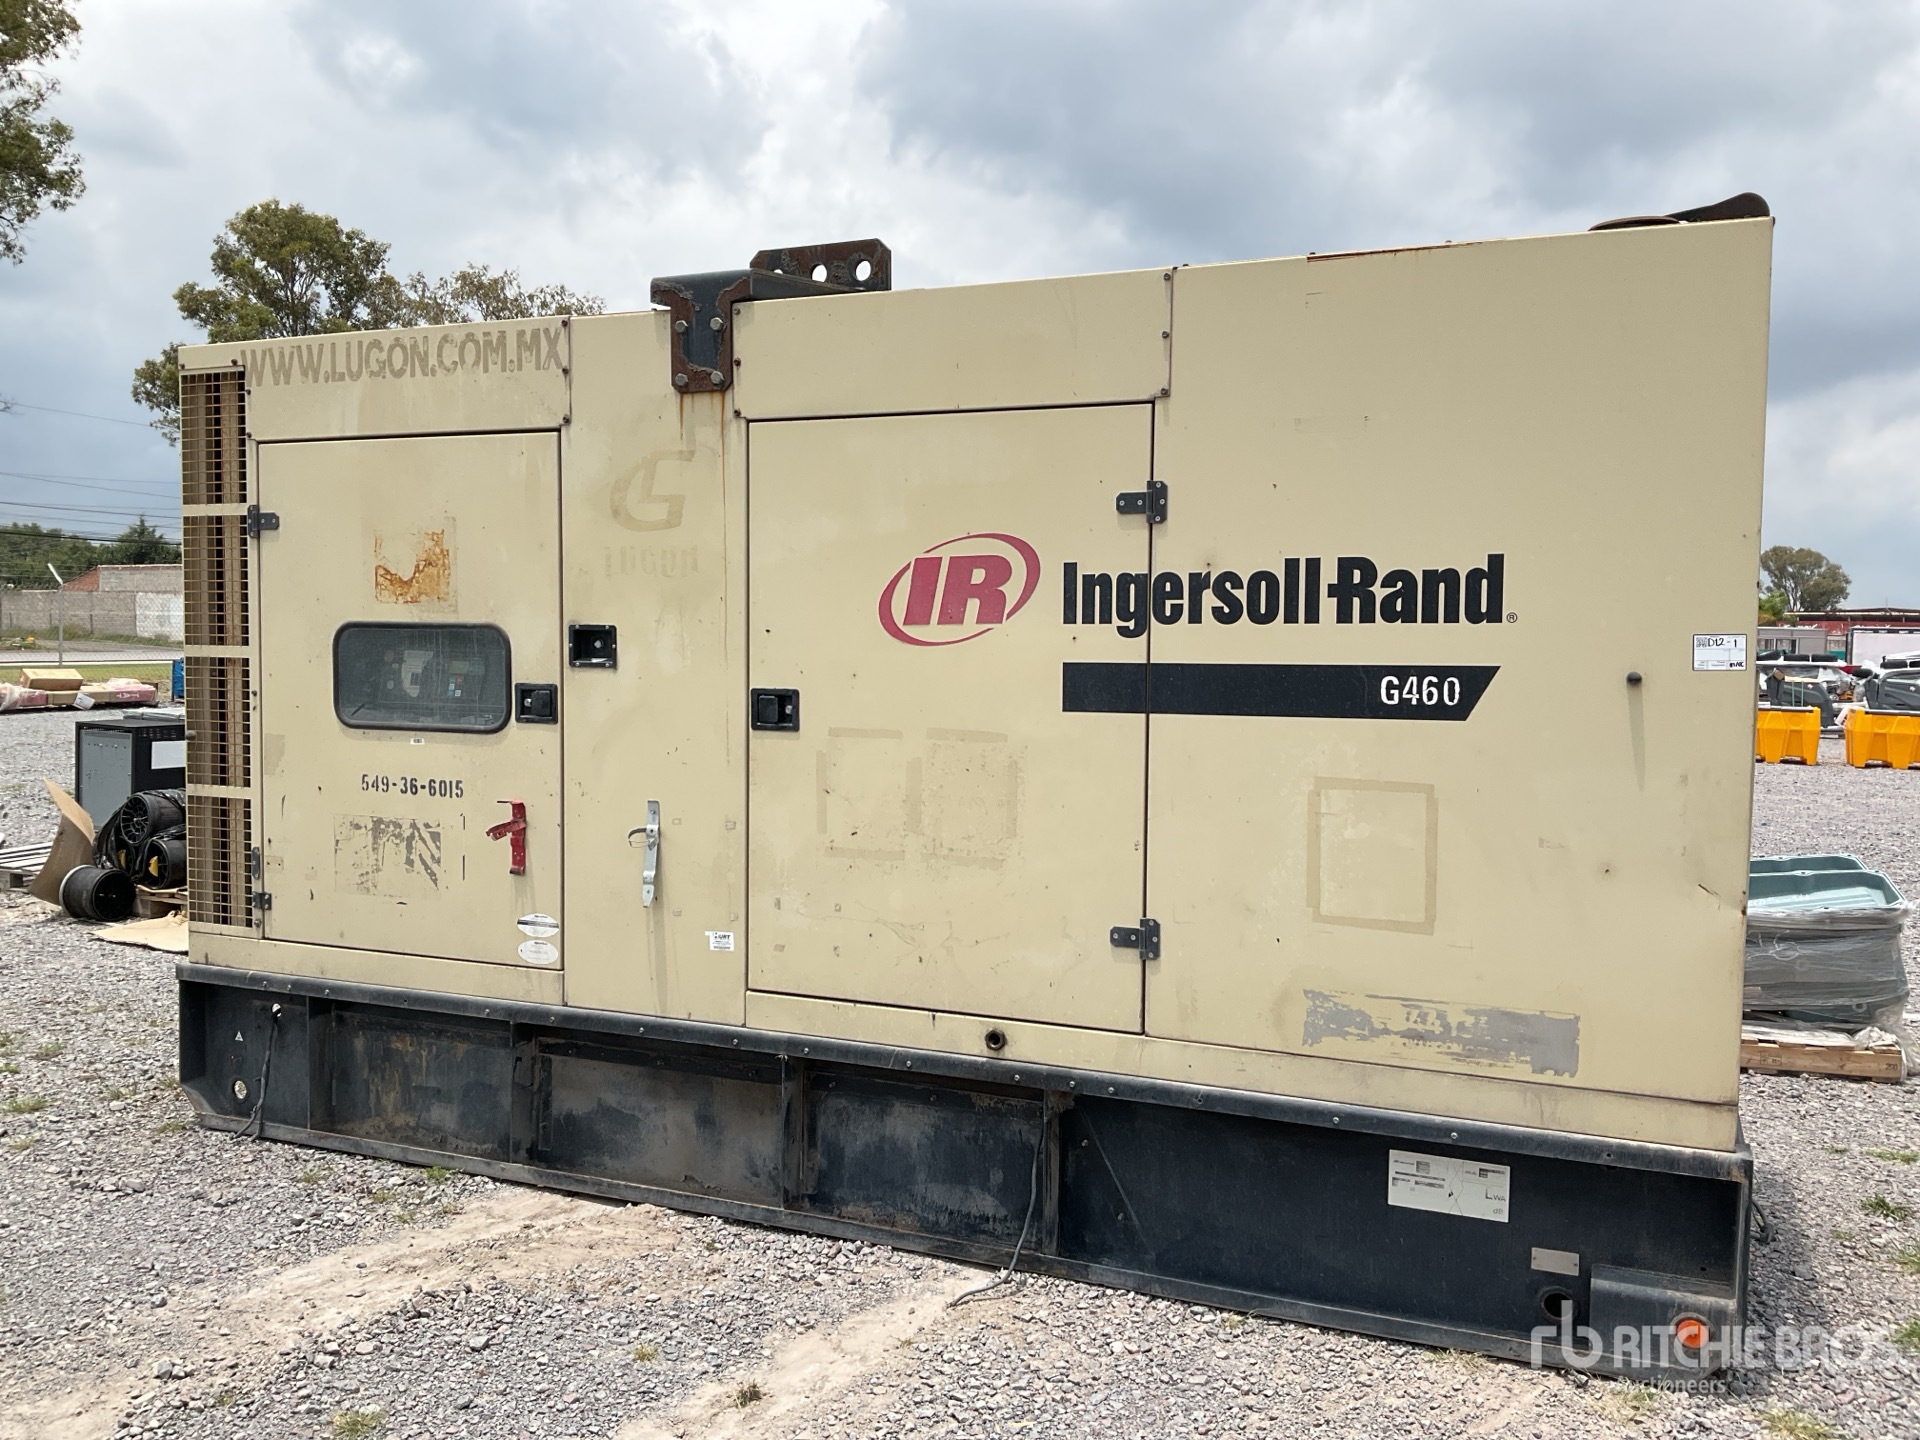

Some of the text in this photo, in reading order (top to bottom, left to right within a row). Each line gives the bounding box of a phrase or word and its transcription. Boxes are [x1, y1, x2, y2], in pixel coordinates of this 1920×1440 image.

[240, 327, 564, 388] WWW.LUGON.COM.MX
[903, 554, 1013, 626] IR
[1062, 553, 1505, 639] Ingersoll-Rand
[1380, 675, 1460, 706] G460
[361, 773, 464, 798] 549-36-6015
